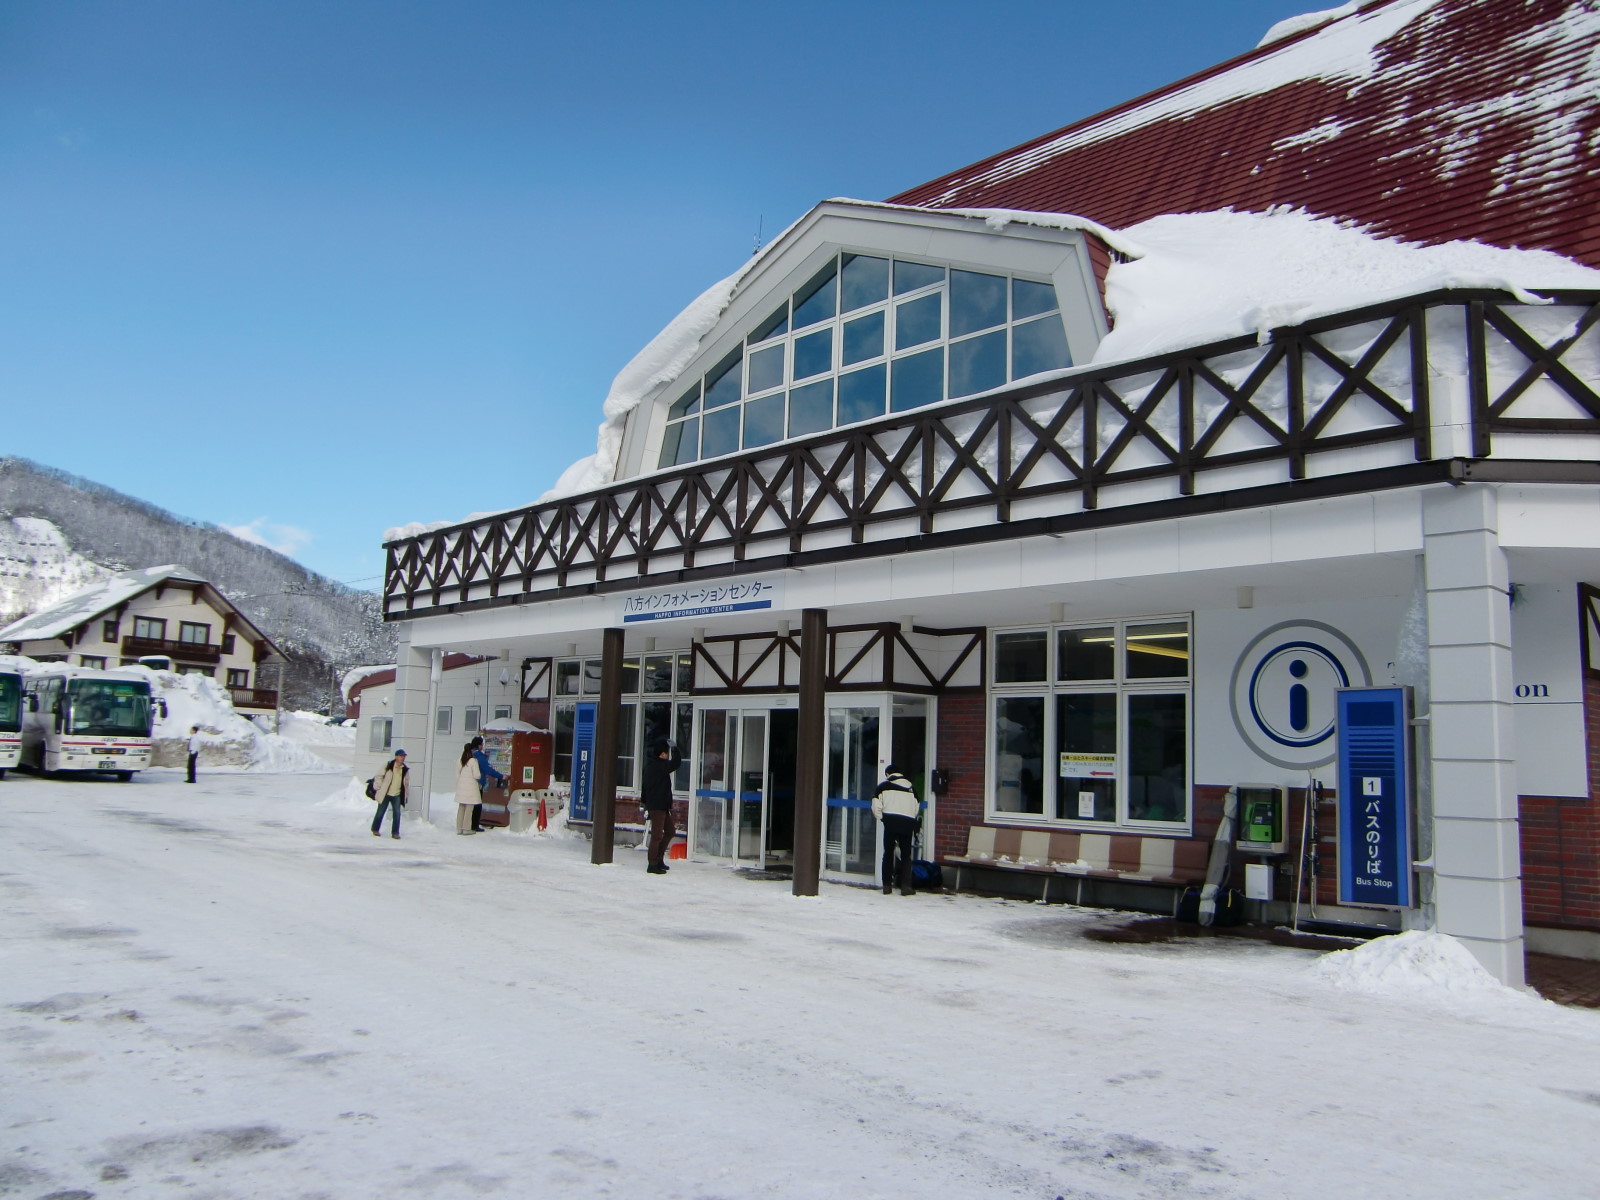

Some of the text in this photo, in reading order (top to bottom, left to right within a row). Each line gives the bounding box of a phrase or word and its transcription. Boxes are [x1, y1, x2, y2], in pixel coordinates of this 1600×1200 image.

[624, 581, 773, 612] 八方インフォメーションセンター
[654, 605, 734, 619] HAPPO INFORMATION CENTER
[1515, 684, 1551, 698] on
[579, 762, 587, 803] バスのりば
[1367, 780, 1375, 792] 1
[1365, 800, 1382, 874] バスのりば
[1356, 877, 1393, 888] Bus Stop
